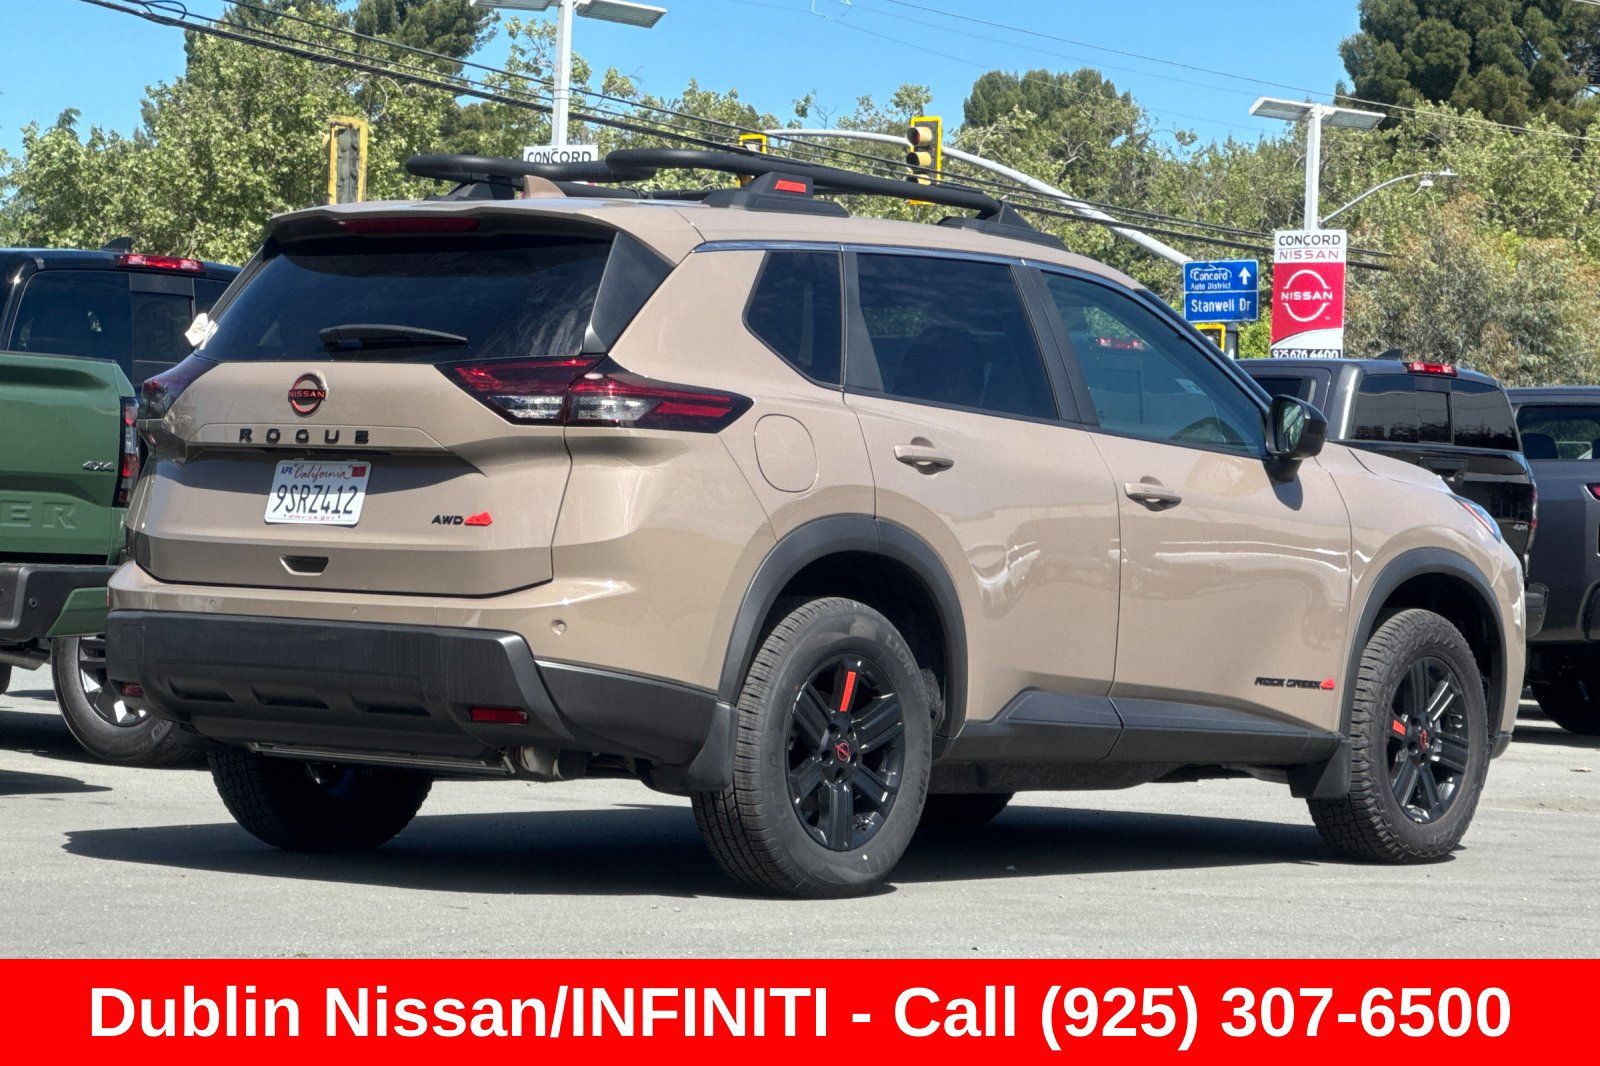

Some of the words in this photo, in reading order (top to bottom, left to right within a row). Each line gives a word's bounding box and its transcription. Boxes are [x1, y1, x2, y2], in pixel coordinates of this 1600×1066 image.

[1278, 234, 1341, 246] CONCORD
[1279, 250, 1339, 260] NISSAN
[1193, 270, 1228, 281] Concord
[1207, 282, 1231, 290] District
[1281, 291, 1333, 300] NISSAN
[1191, 298, 1235, 312] Stanwell
[1239, 297, 1251, 312] Dr
[288, 389, 326, 398] NISSAN
[239, 428, 369, 444] ROGUE
[280, 466, 293, 475] APR
[293, 464, 350, 482] California
[272, 484, 359, 514] 9SRZ412
[431, 514, 464, 526] AWD
